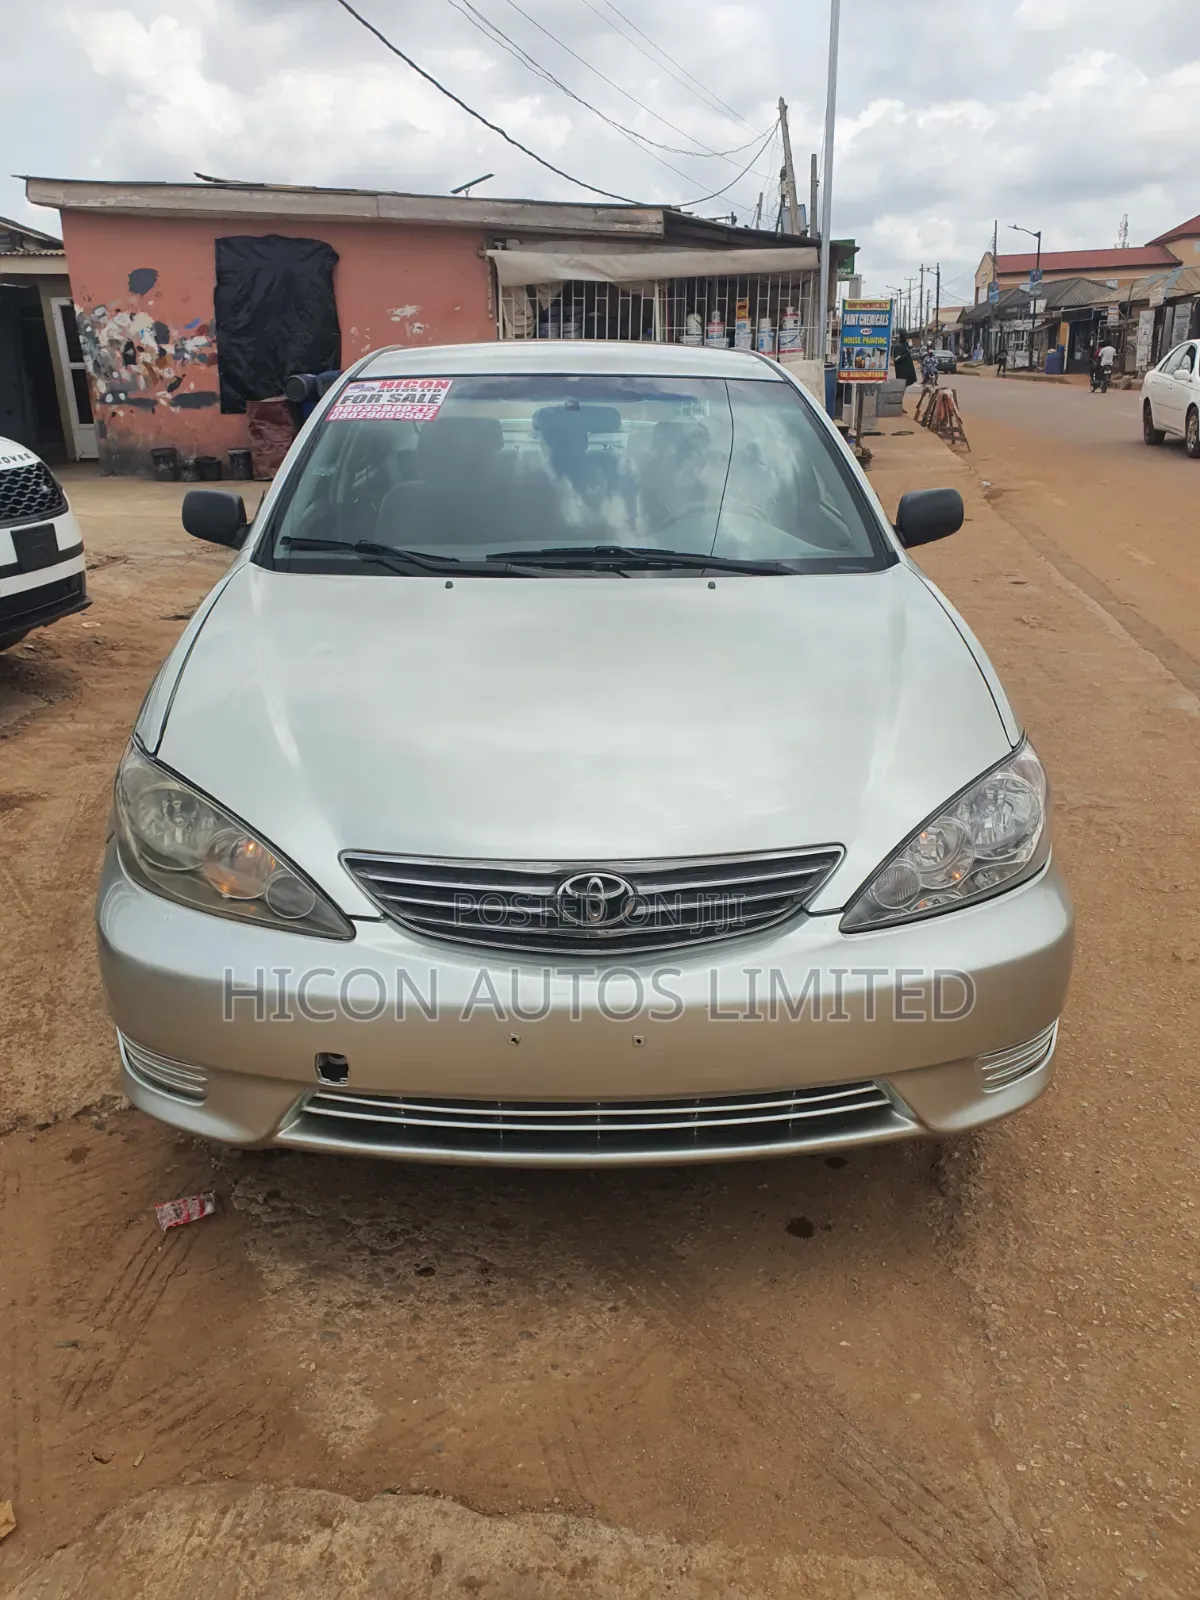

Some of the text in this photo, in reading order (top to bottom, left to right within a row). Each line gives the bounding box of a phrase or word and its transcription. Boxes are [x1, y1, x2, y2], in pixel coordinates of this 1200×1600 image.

[843, 313, 889, 326] PAINT CHEMICALS
[378, 380, 451, 389] HICON
[339, 393, 443, 405] FOR SALE
[0, 452, 32, 464] OVER
